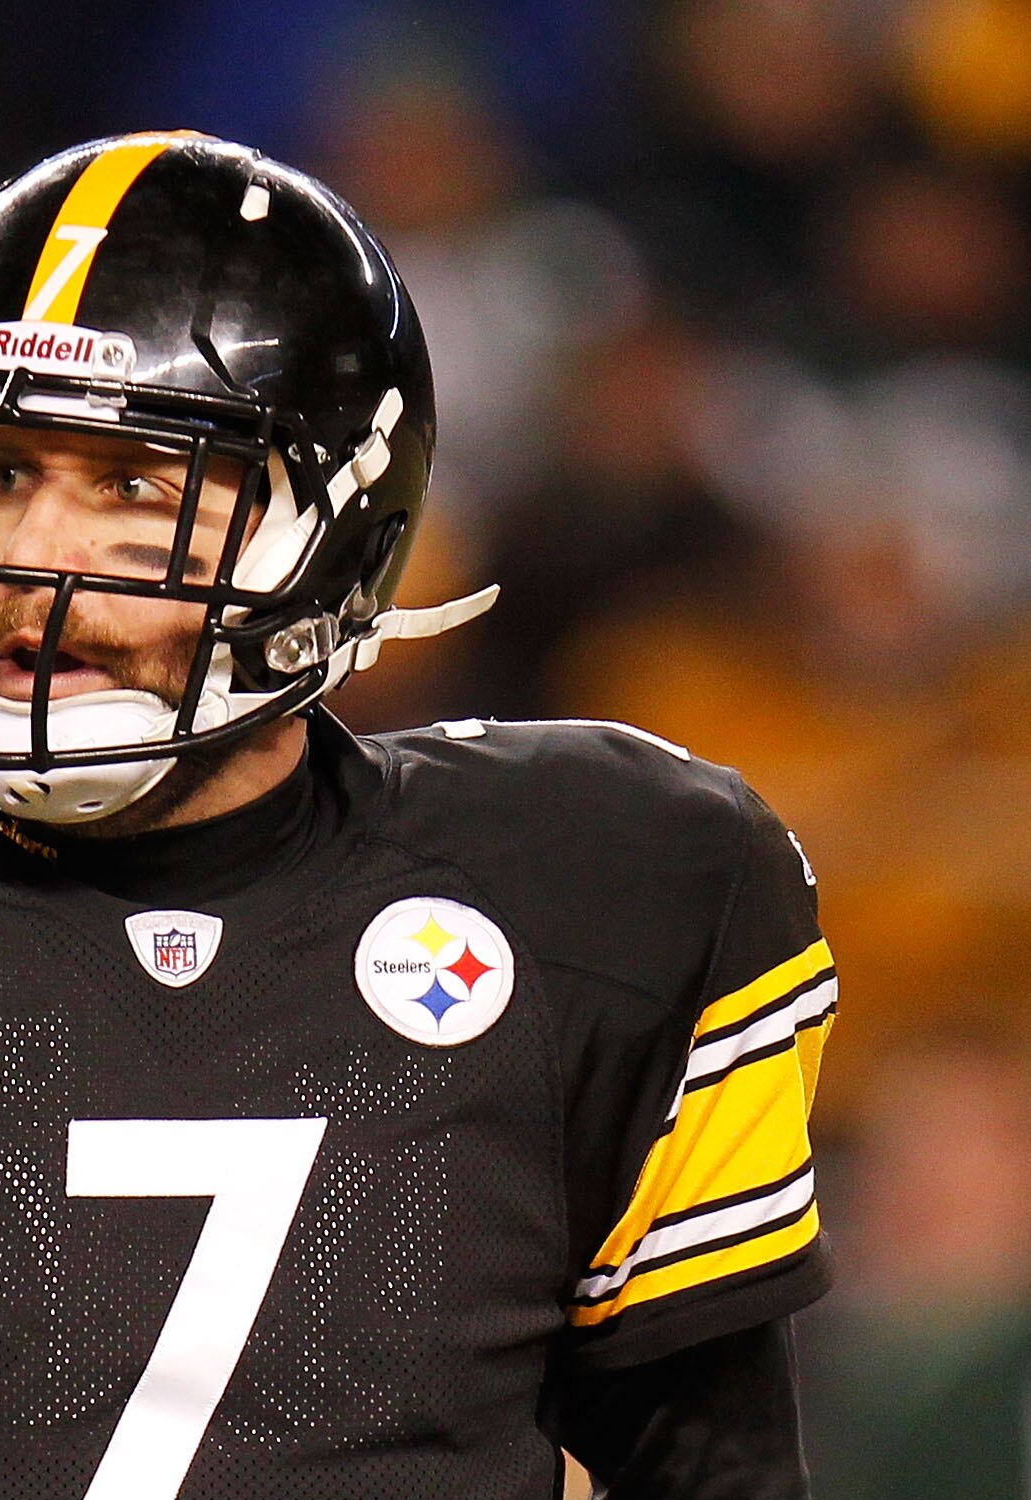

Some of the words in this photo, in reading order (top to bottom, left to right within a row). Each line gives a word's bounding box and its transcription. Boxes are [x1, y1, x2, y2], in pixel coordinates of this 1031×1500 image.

[21, 224, 108, 321] 7
[157, 947, 192, 971] NFL
[373, 958, 431, 974] Steelers
